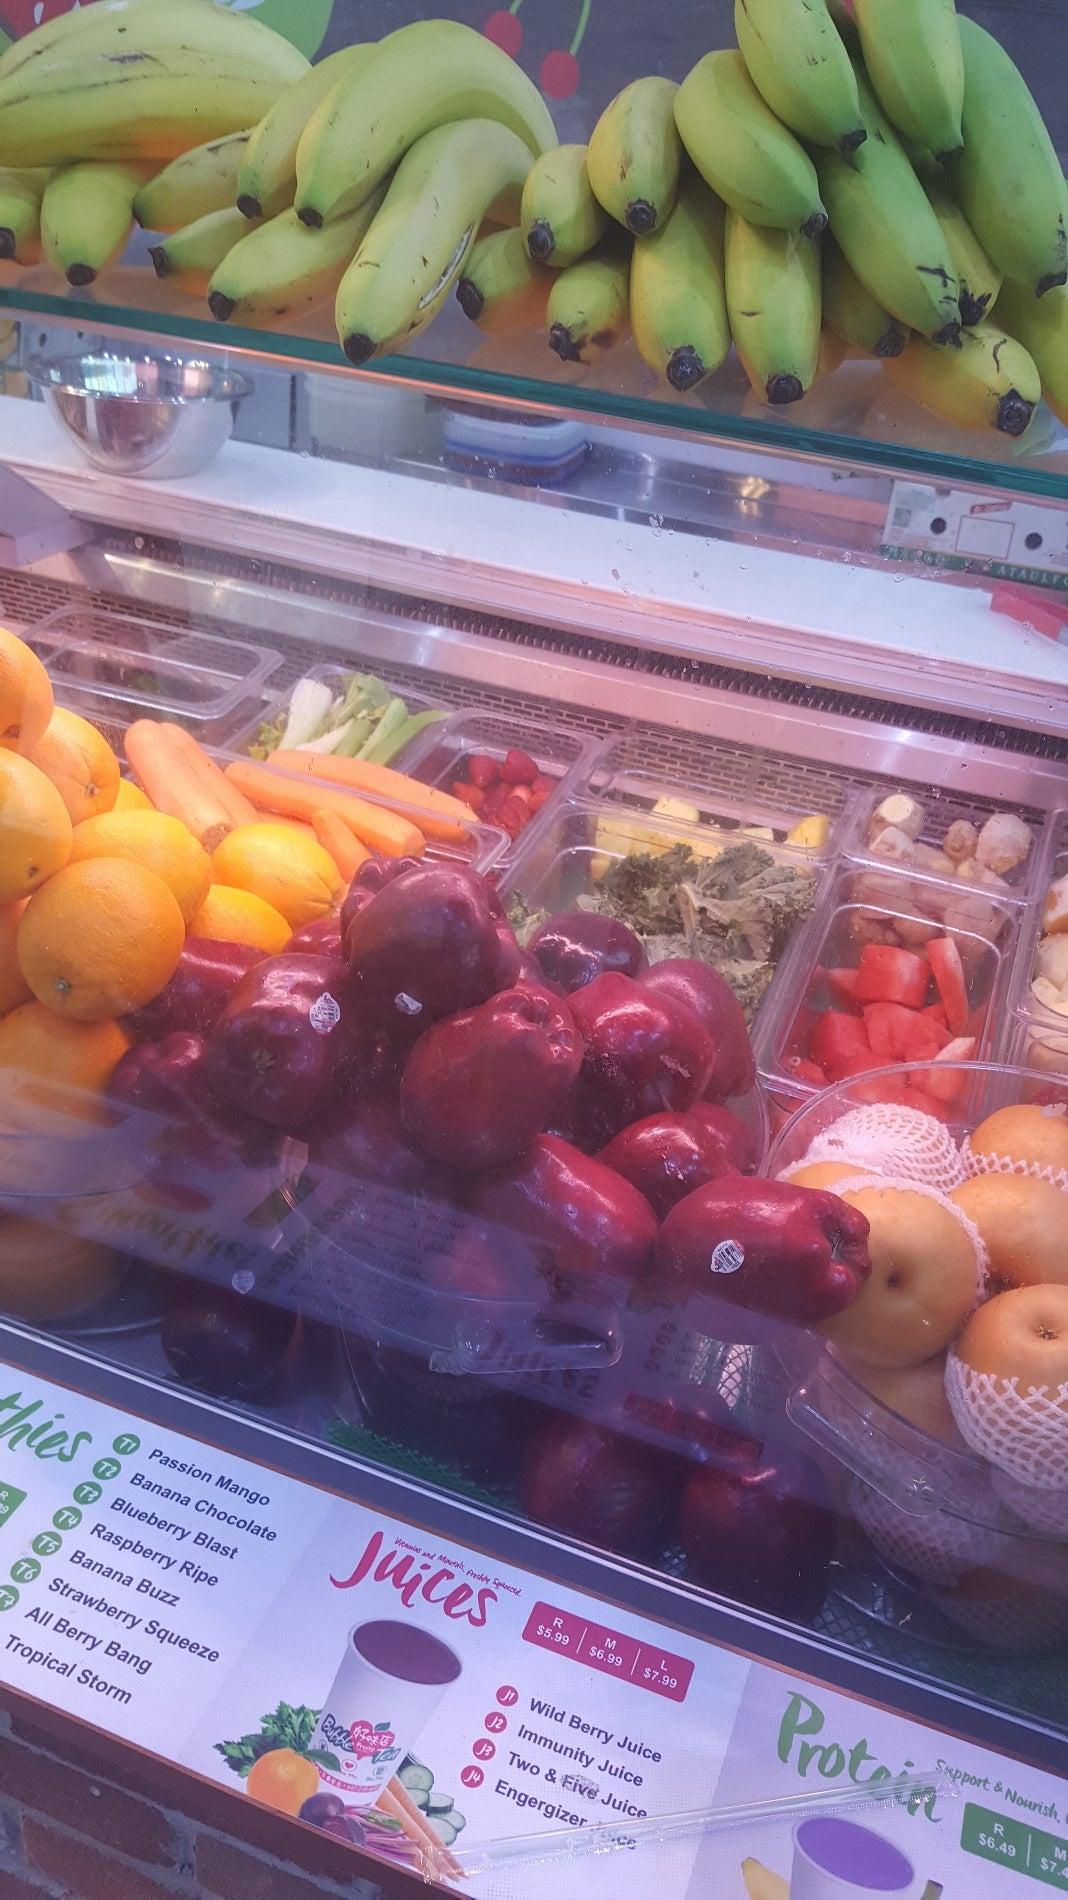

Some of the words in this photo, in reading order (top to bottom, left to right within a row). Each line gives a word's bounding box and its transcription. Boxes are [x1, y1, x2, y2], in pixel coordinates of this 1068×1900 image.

[129, 1472, 191, 1507] Banana
[194, 1499, 277, 1542] Chocolate
[148, 1448, 213, 1484] Passion
[215, 1474, 271, 1508] Mango
[90, 1523, 178, 1571] Raspberry
[179, 1559, 219, 1588] Ripe
[110, 1497, 192, 1541] Blueberry
[193, 1532, 240, 1560] Blast
[69, 1549, 134, 1588] Banana
[136, 1578, 181, 1607] Buzz
[330, 1531, 498, 1627] Juices
[394, 1537, 421, 1553] Vitamins
[422, 1551, 436, 1561] and
[466, 1569, 490, 1585] Freshly
[24, 1606, 54, 1628] All
[53, 1616, 104, 1651] Berry
[103, 1640, 153, 1677] Bang
[48, 1577, 143, 1630] Strawberry
[144, 1619, 220, 1663] Squeeze
[553, 1617, 563, 1629] R
[605, 1637, 617, 1650] M
[660, 1659, 668, 1672] L
[4, 1634, 77, 1678] Tropical
[77, 1668, 132, 1704] Storm
[536, 1625, 570, 1646] $5.99
[589, 1646, 623, 1667] $6.99
[643, 1667, 678, 1689] $7.99
[517, 1724, 595, 1768] Immunity
[598, 1760, 644, 1787] Juice
[530, 1698, 566, 1724] Wild
[568, 1714, 614, 1744] Berry
[617, 1736, 663, 1763] Juice
[494, 1779, 588, 1828] Engergizer
[508, 1751, 541, 1776] Two
[544, 1768, 557, 1783] &
[561, 1775, 599, 1800] Five
[601, 1793, 648, 1818] Juice
[935, 1759, 990, 1792] Support
[993, 1781, 1003, 1793] &
[1004, 1788, 1060, 1823] Nourish,
[979, 1833, 1016, 1857] $6.49
[993, 1823, 1004, 1837] R
[1054, 1846, 1067, 1861] M
